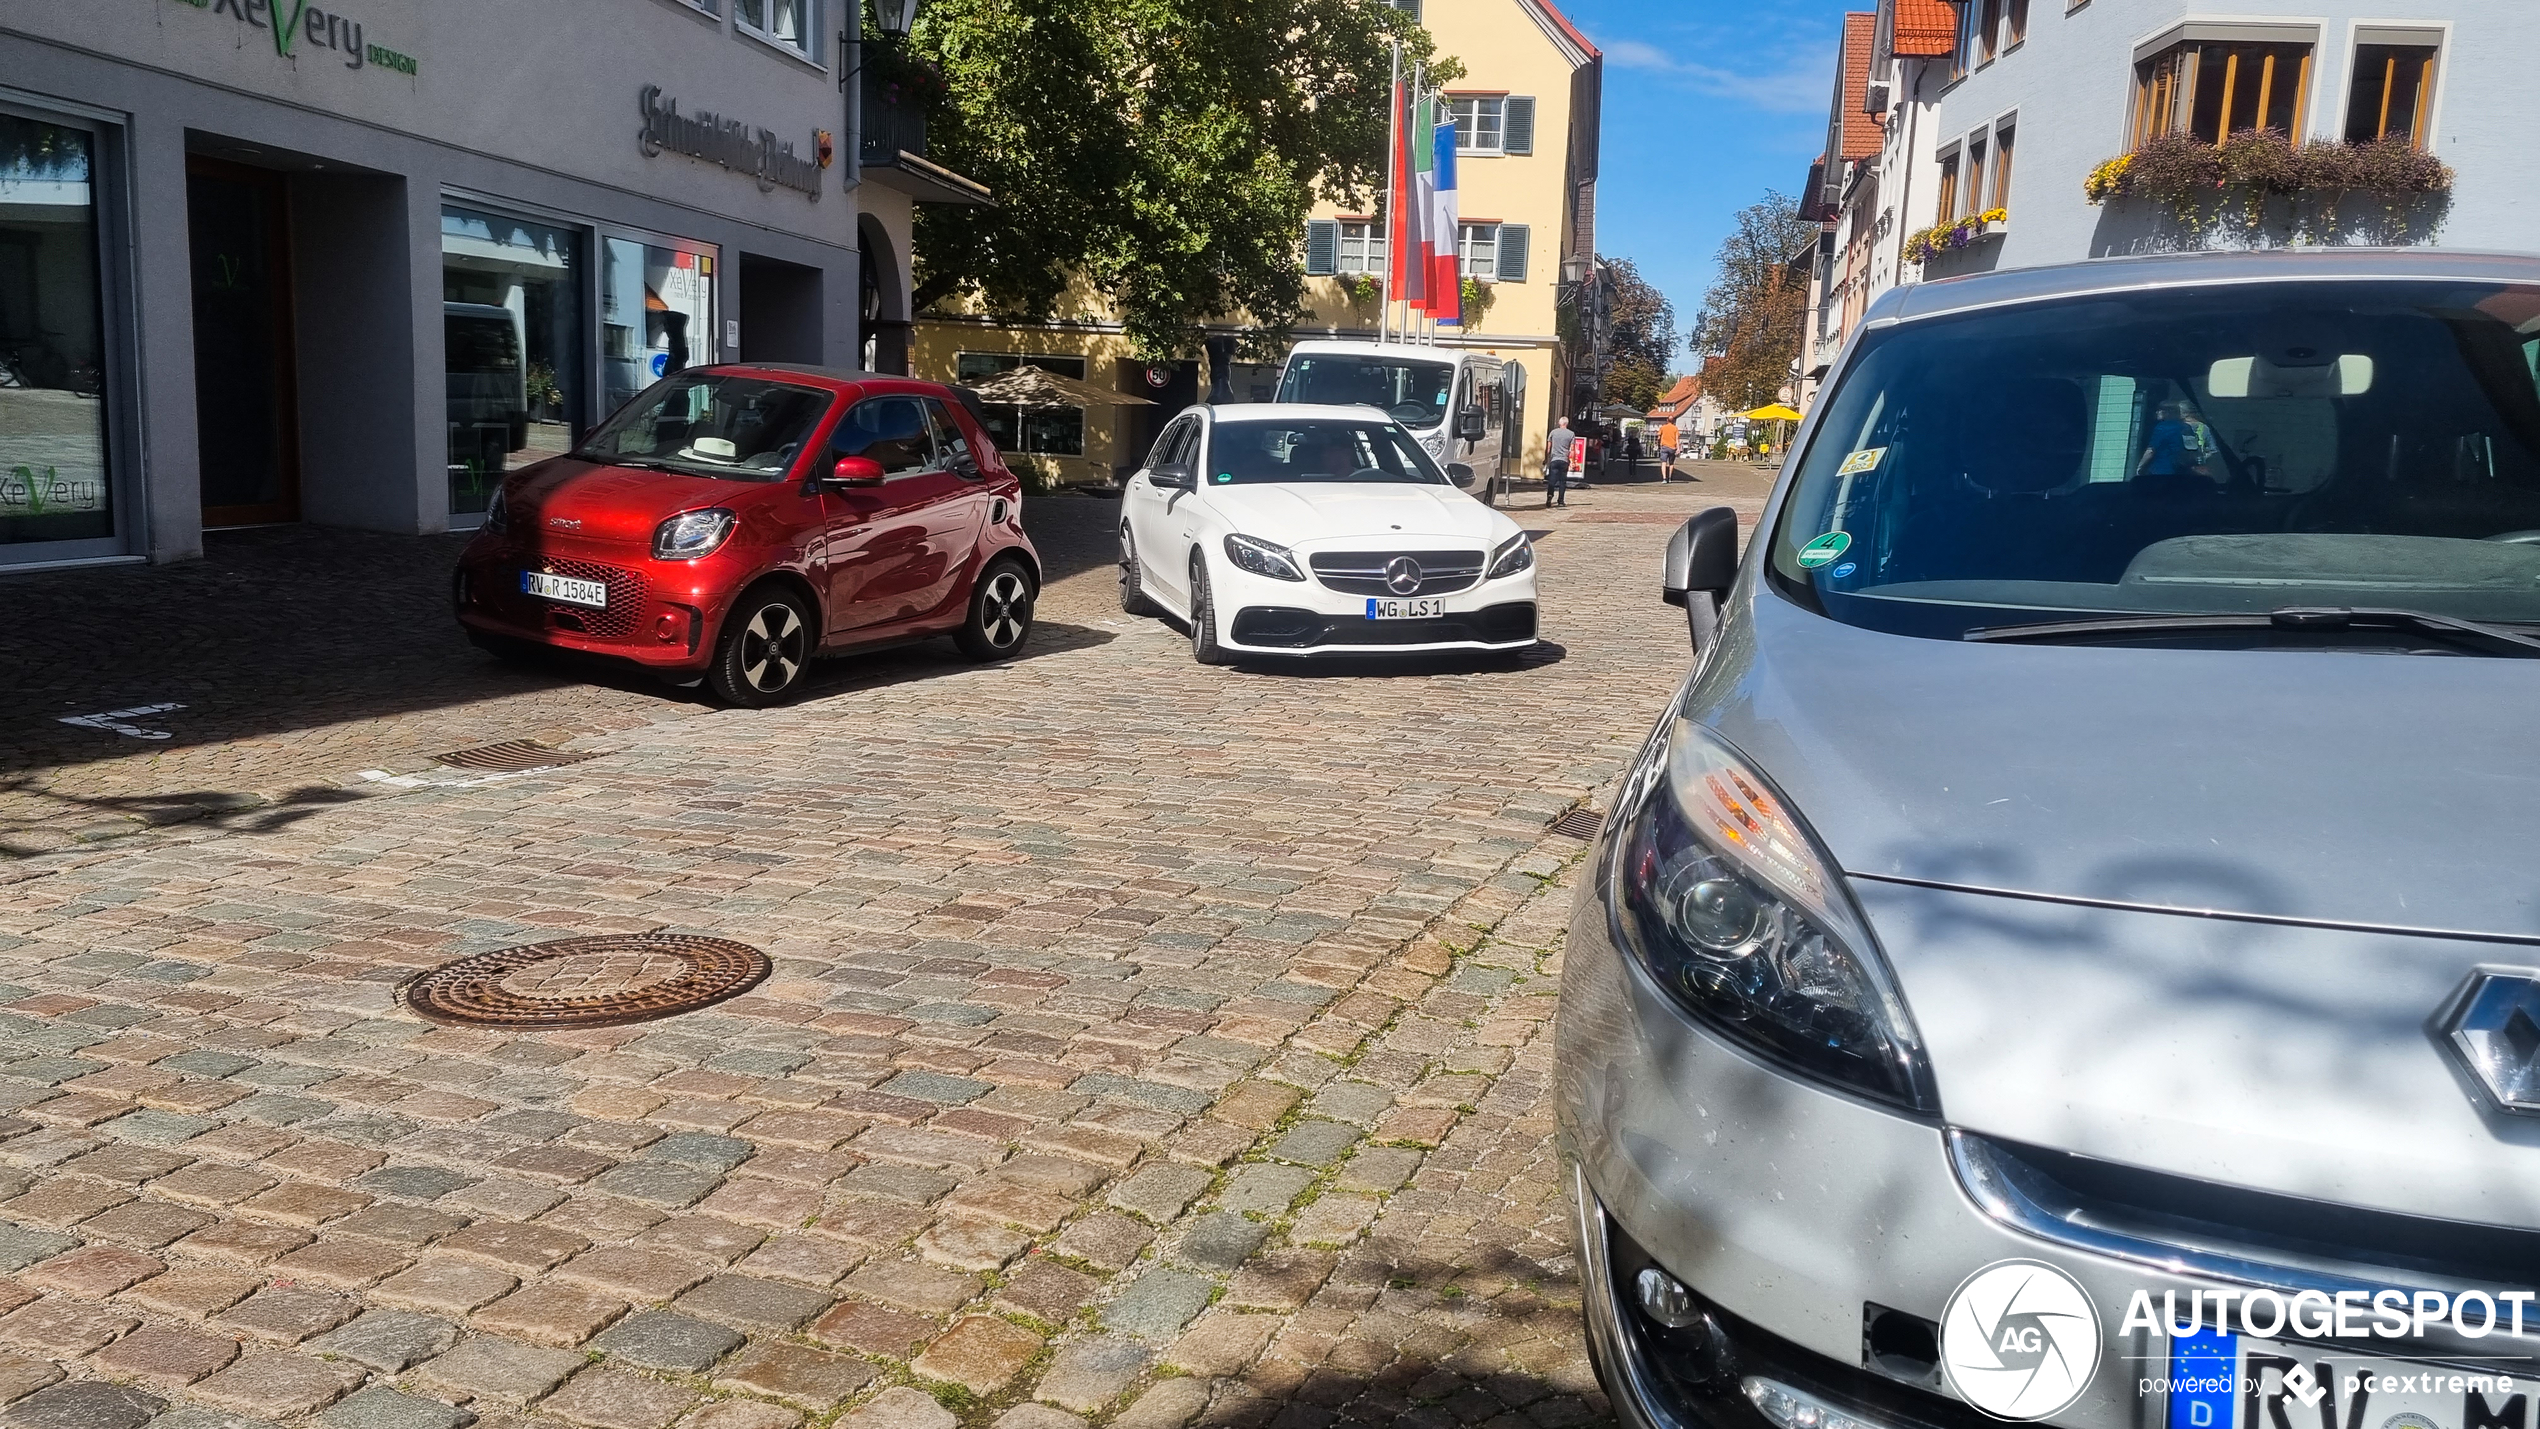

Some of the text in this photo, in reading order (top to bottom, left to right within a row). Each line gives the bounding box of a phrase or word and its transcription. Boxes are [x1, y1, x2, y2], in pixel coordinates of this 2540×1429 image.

[367, 44, 417, 75] DESIGN
[1152, 370, 1166, 380] 50
[549, 518, 581, 529] smart
[1820, 533, 1840, 549] 4
[528, 574, 603, 603] RV R 1584E
[1377, 600, 1442, 617] WG LS 1
[2190, 1401, 2213, 1427] D
